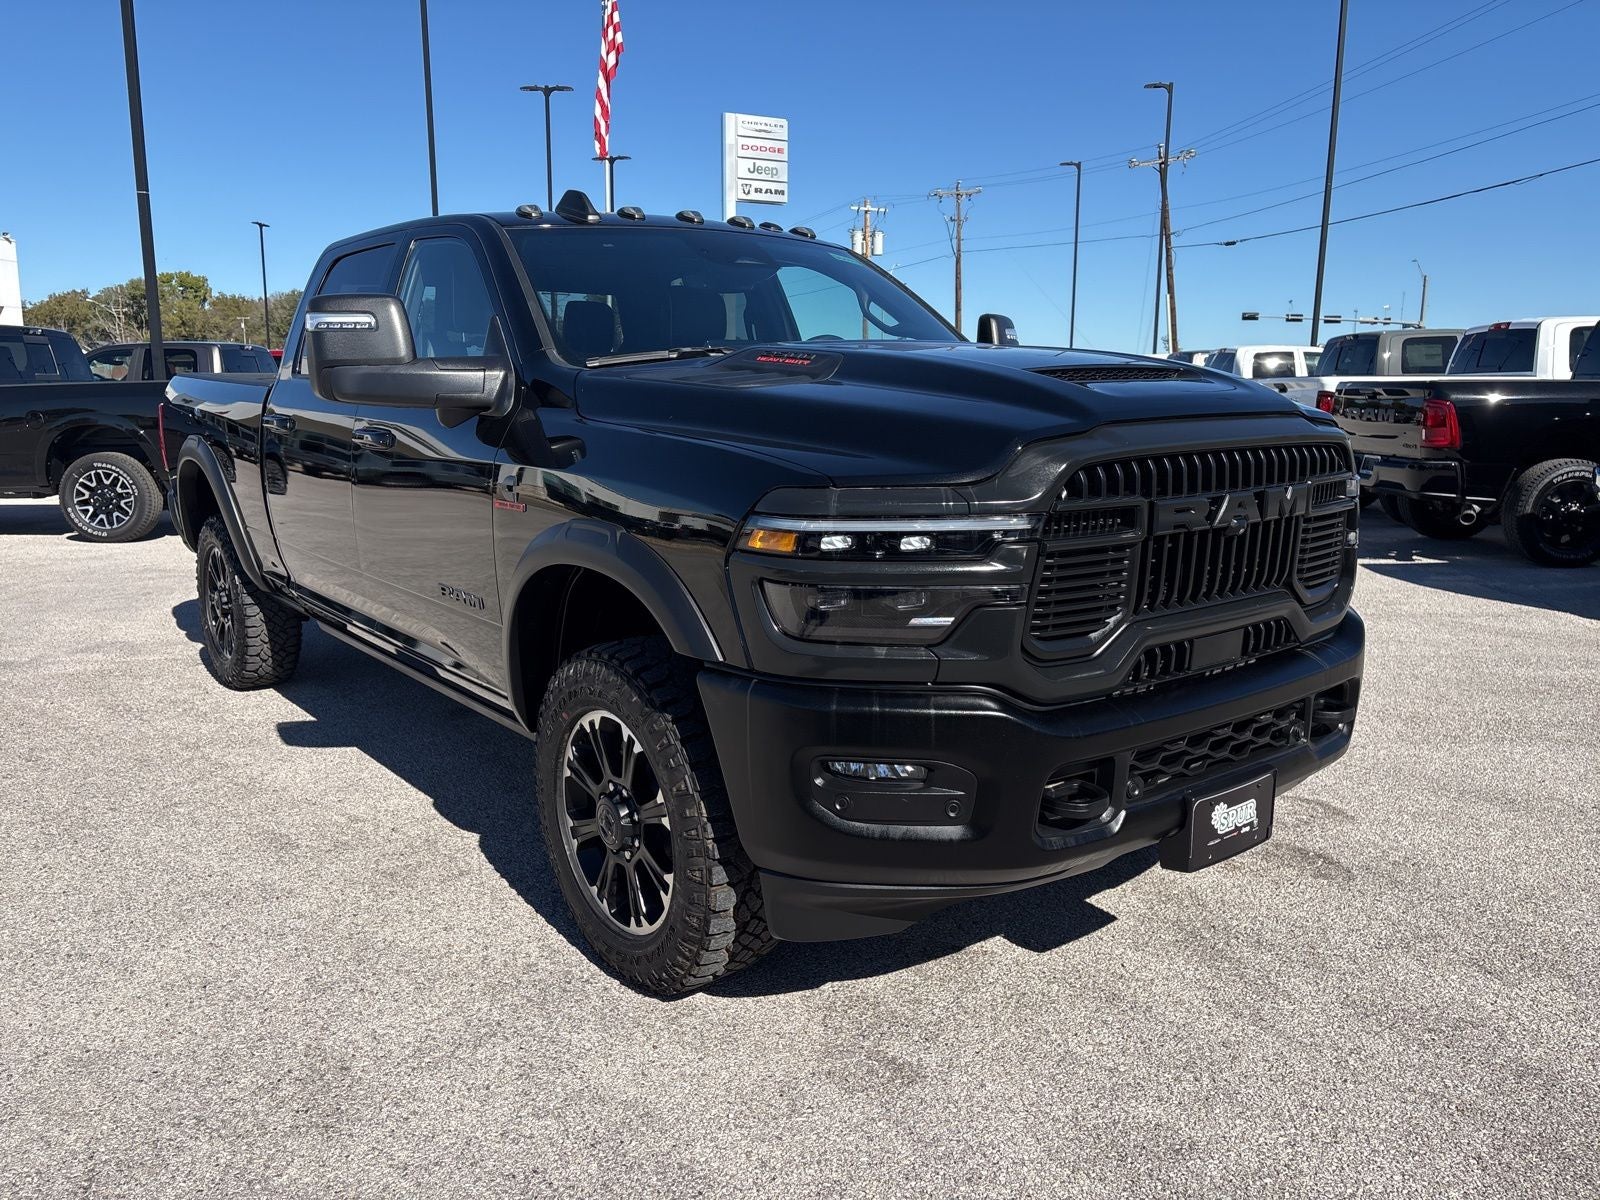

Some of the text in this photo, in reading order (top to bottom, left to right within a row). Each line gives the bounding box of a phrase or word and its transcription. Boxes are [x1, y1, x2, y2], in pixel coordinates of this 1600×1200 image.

[741, 120, 784, 129] CHRYSLER
[741, 144, 785, 154] DODGE
[747, 161, 779, 178] Jeep
[754, 187, 785, 196] RAM
[784, 358, 812, 366] DUTY
[1345, 407, 1396, 422] RAM
[1152, 483, 1309, 536] RAM
[1219, 801, 1256, 833] SPUR
